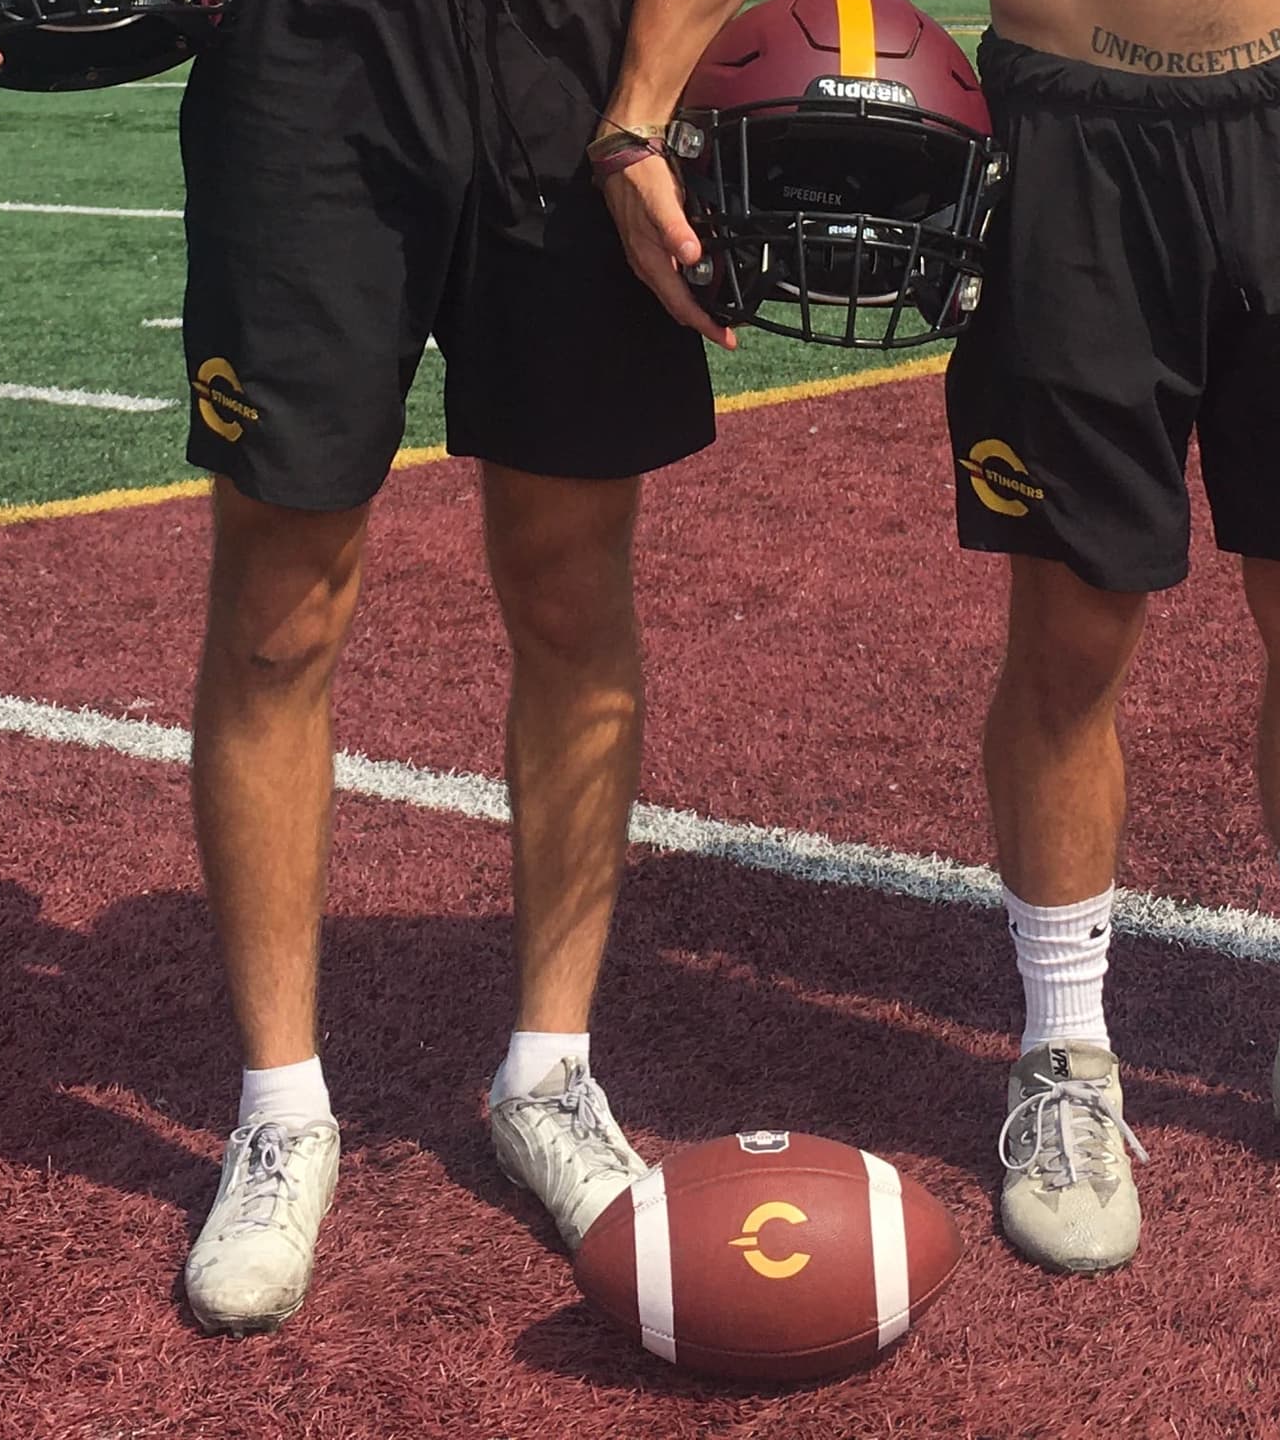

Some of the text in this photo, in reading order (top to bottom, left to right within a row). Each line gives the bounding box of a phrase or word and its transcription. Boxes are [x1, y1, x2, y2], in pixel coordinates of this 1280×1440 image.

[818, 78, 907, 104] Riddell
[783, 185, 843, 207] SPEEDFLEX
[828, 224, 879, 240] Riddll
[211, 388, 260, 420] STINGERS
[984, 468, 1045, 500] STINGERS
[1050, 1048, 1069, 1079] VPR
